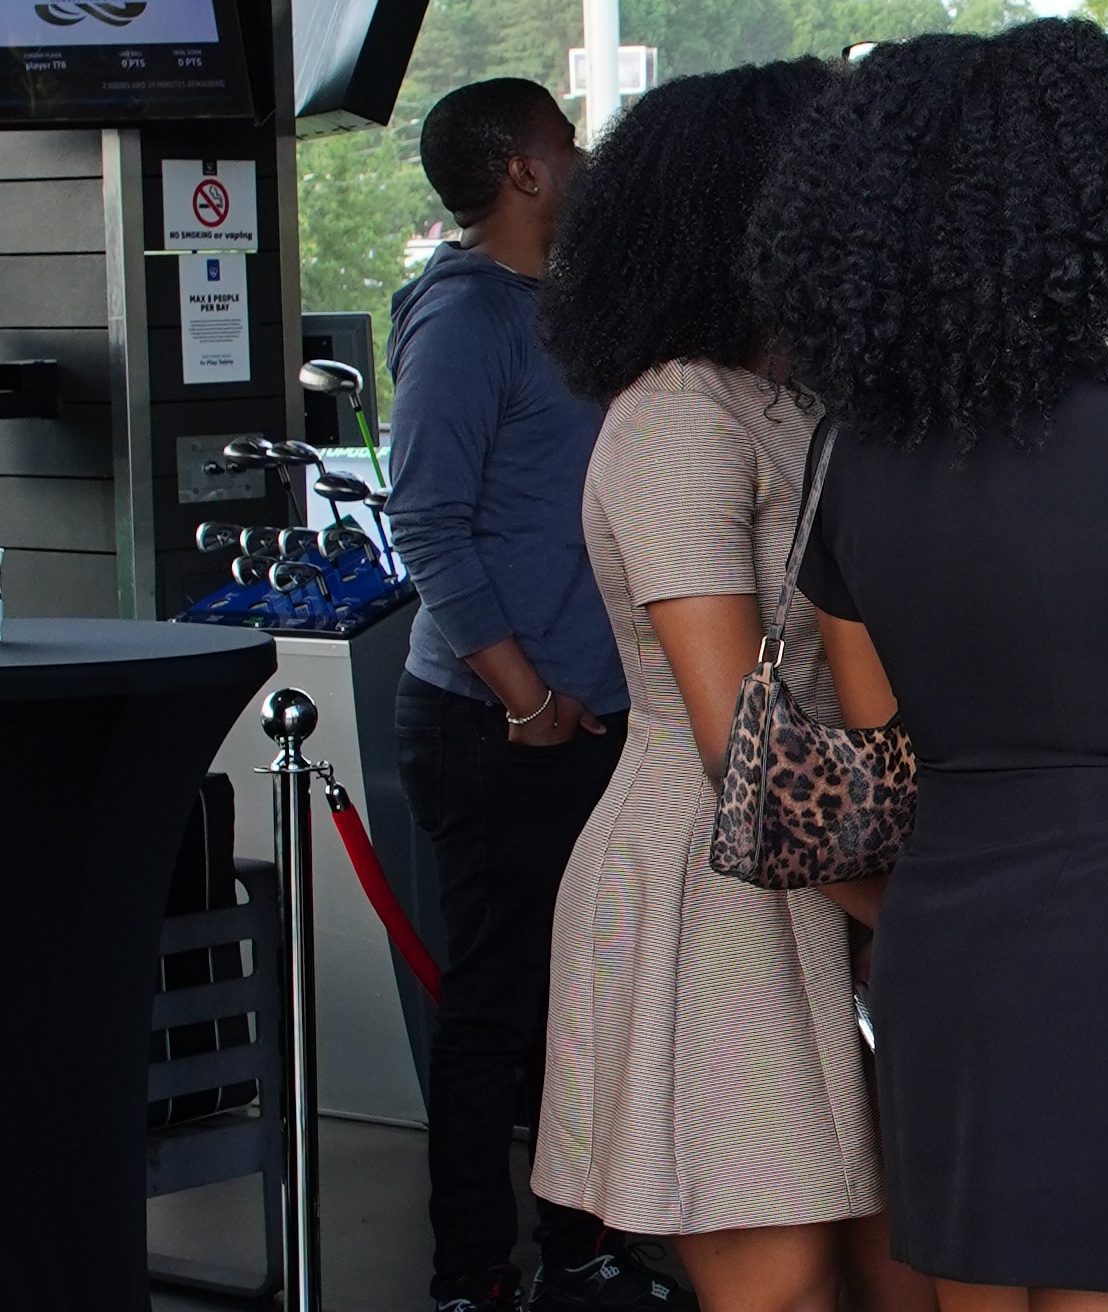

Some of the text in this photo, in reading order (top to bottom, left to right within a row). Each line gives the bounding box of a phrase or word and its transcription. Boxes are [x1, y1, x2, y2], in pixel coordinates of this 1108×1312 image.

[169, 231, 179, 239] NO
[181, 231, 213, 239] SMOKING
[225, 230, 252, 241] vaping
[189, 294, 206, 304] MAX
[213, 294, 239, 302] PEOPLE
[200, 303, 229, 312] PER BAY
